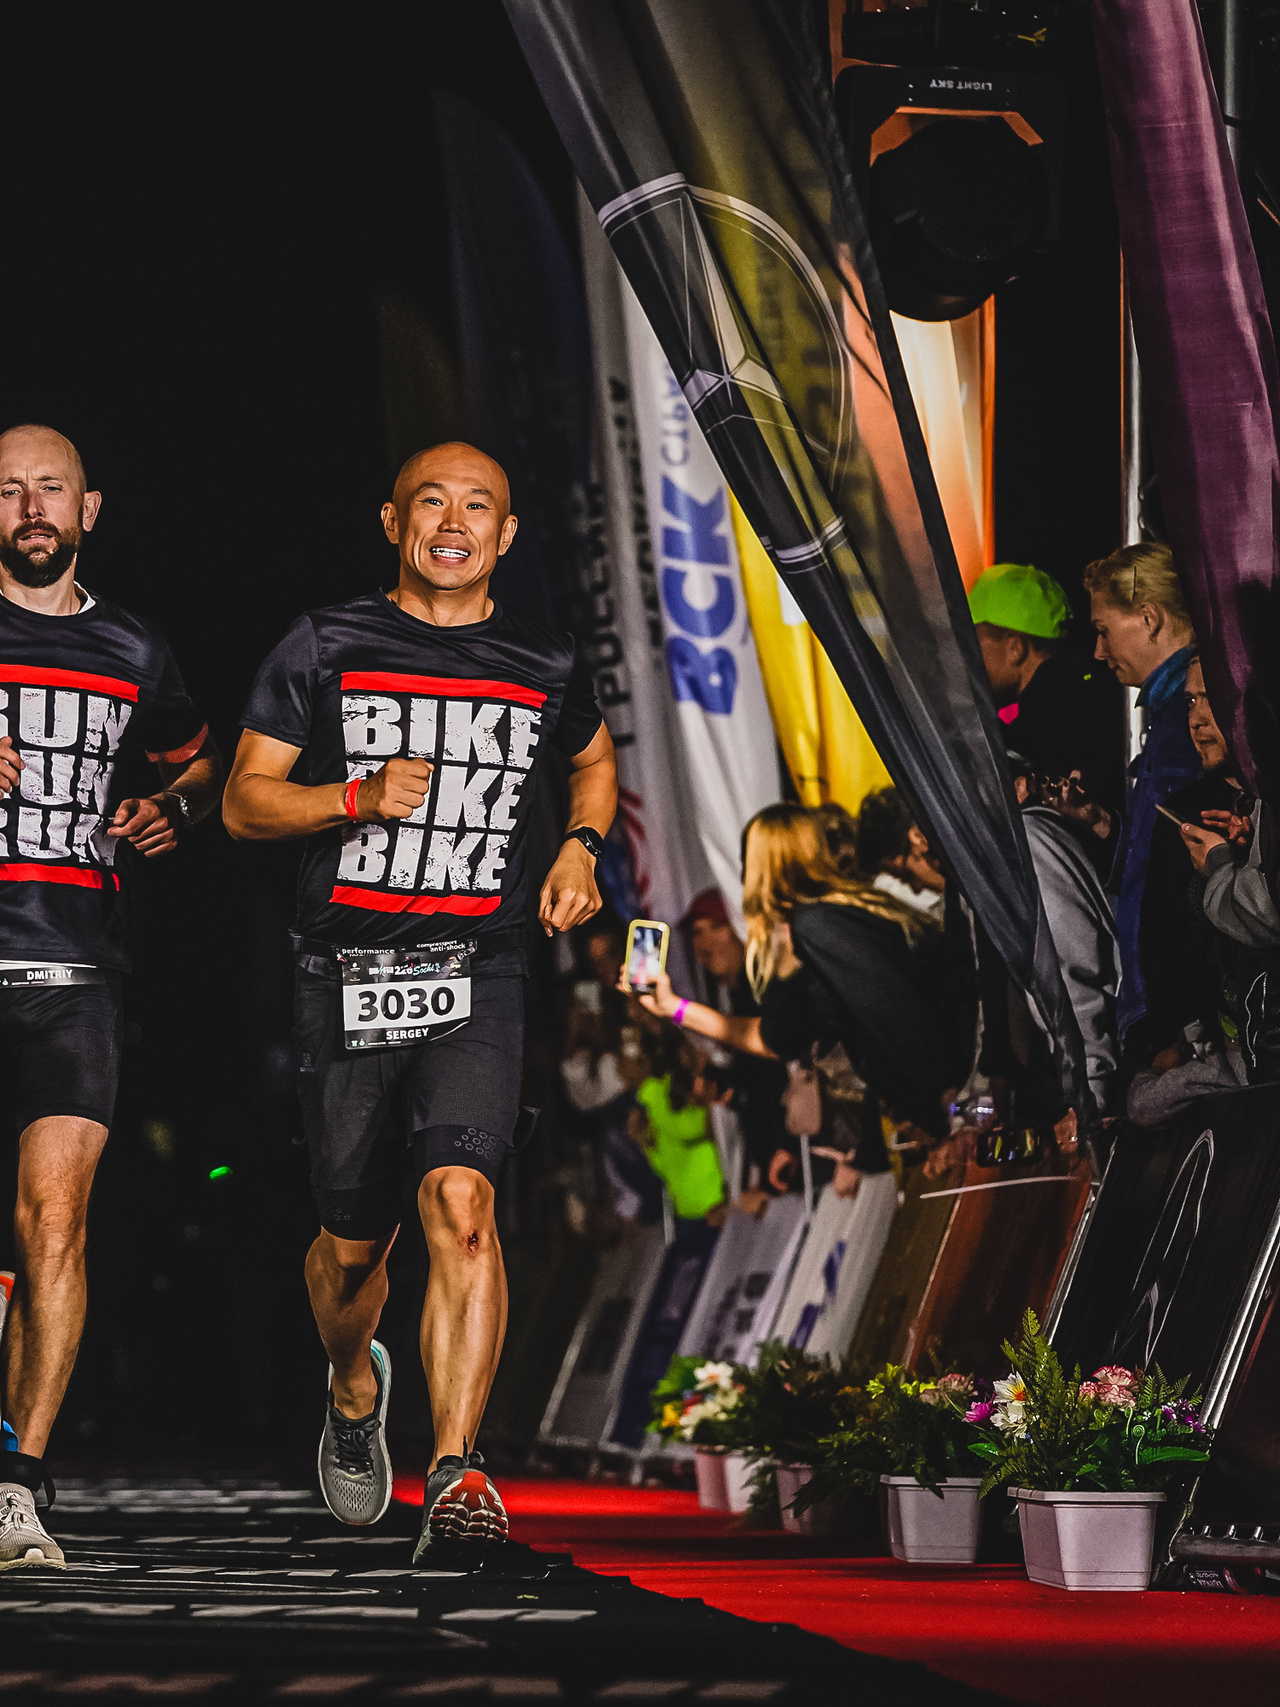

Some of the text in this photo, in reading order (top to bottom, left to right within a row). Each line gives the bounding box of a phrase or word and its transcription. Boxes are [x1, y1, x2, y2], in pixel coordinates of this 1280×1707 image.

[929, 78, 993, 91] LIGHT SKY
[341, 695, 542, 770] BIKE
[345, 760, 527, 831] KE
[336, 824, 510, 890] BIKE
[26, 969, 74, 981] DMITRIY
[357, 986, 456, 1023] 3030
[386, 1027, 430, 1040] SERGEY
